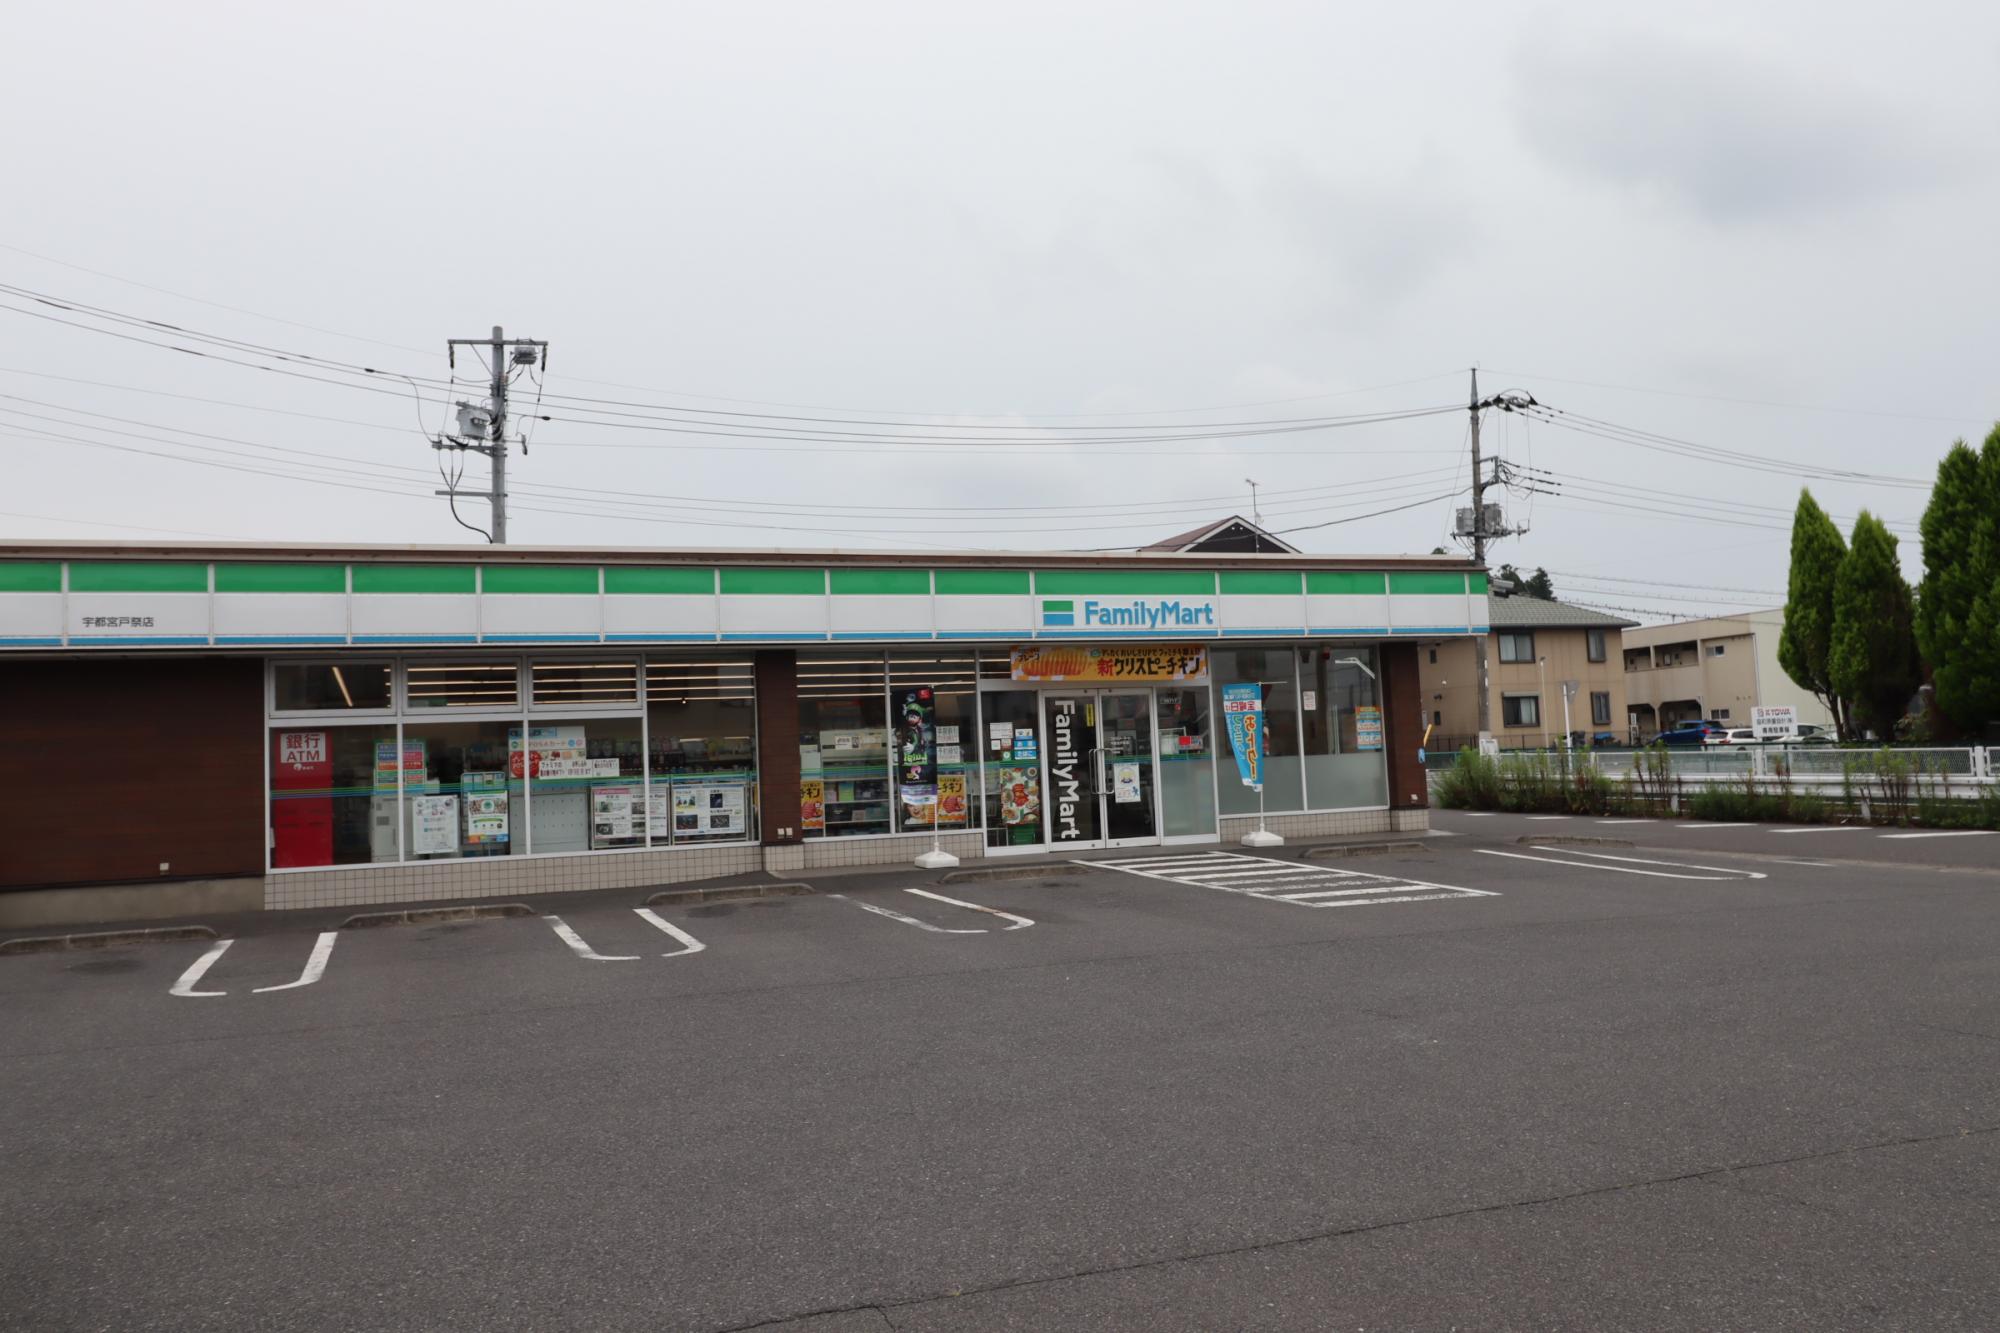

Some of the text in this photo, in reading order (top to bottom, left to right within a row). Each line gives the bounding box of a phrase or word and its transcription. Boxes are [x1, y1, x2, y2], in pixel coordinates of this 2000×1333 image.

[82, 616, 154, 628] 宇都宮戸祭店
[1084, 601, 1213, 628] FamilyMart
[1097, 657, 1200, 677] 新クリスピーチキン
[286, 734, 321, 749] 銀行
[287, 750, 320, 761] ATM
[1051, 700, 1081, 839] FamilyMart
